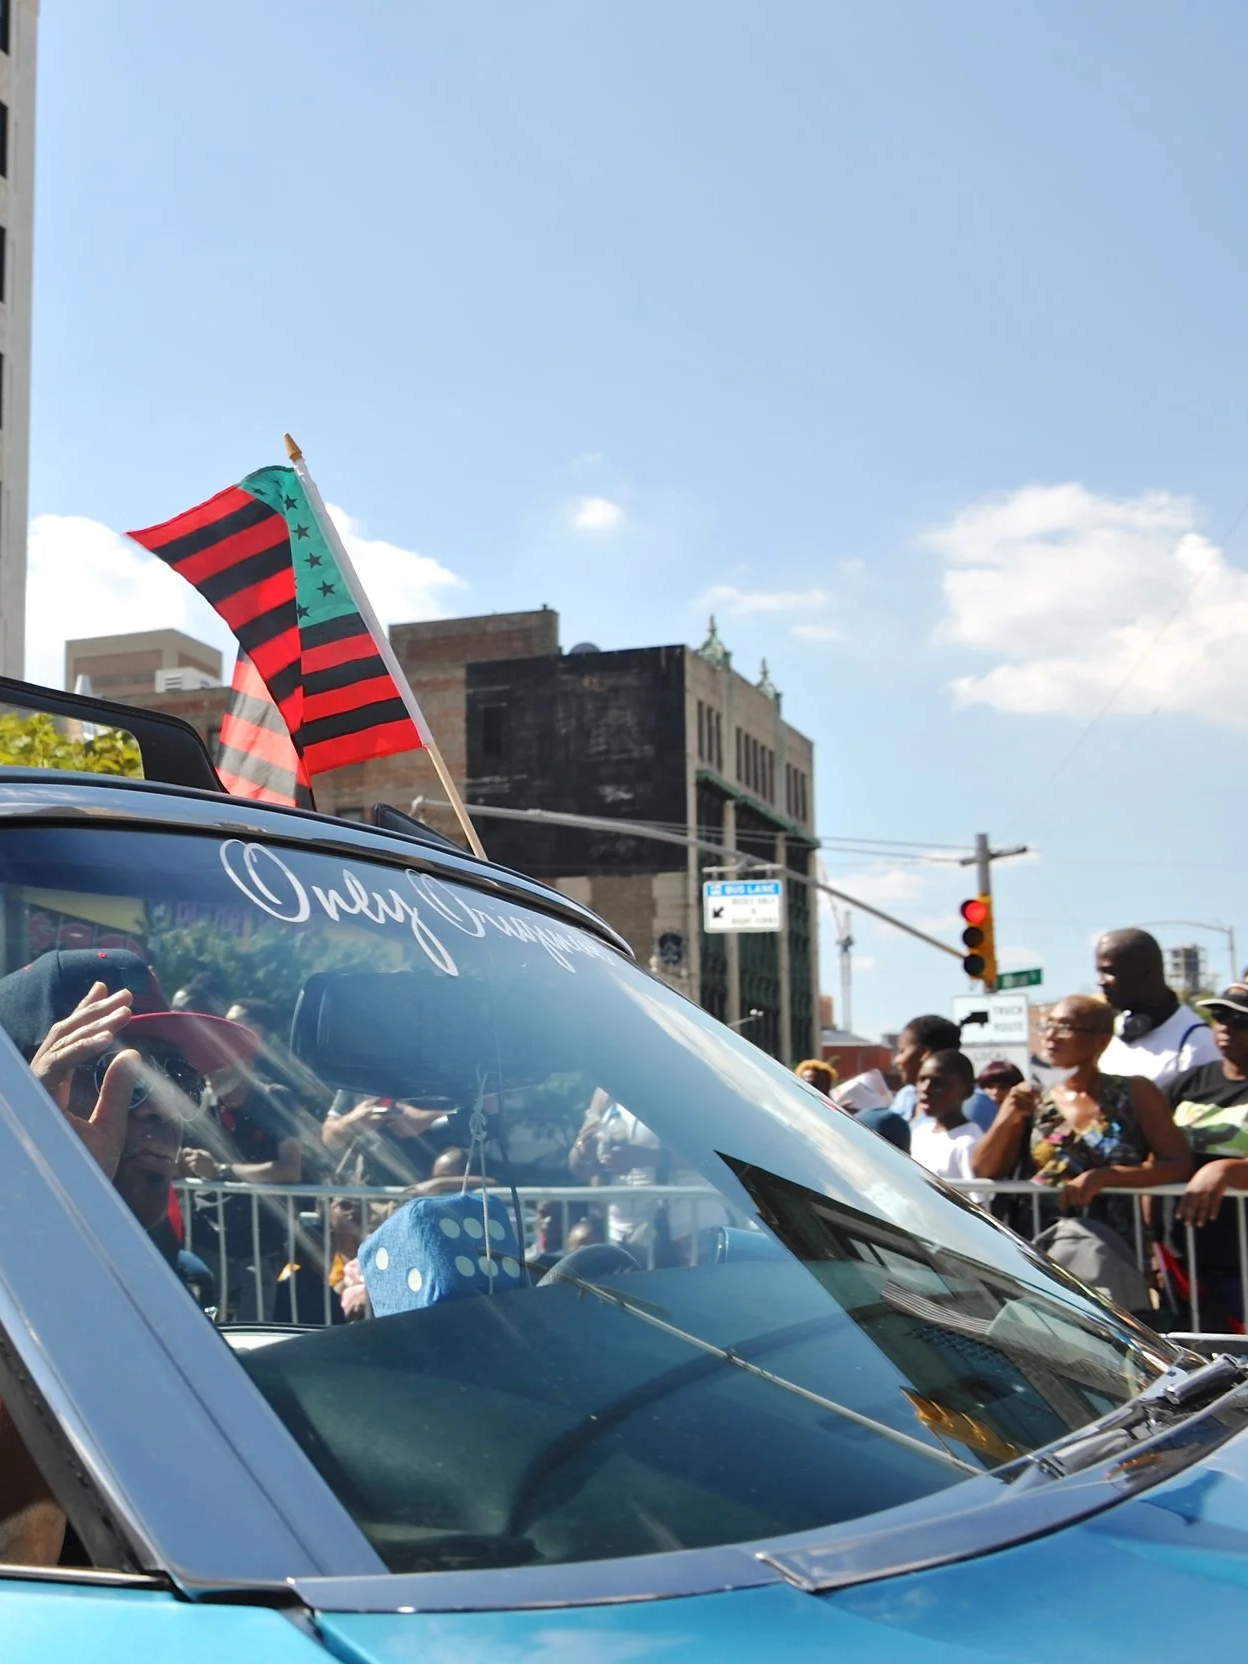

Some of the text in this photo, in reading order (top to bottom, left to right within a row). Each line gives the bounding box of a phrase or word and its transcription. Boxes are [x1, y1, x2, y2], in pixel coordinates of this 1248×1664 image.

[747, 883, 775, 894] LANE
[219, 839, 459, 977] Only
[993, 1005, 1023, 1015] TRUCK
